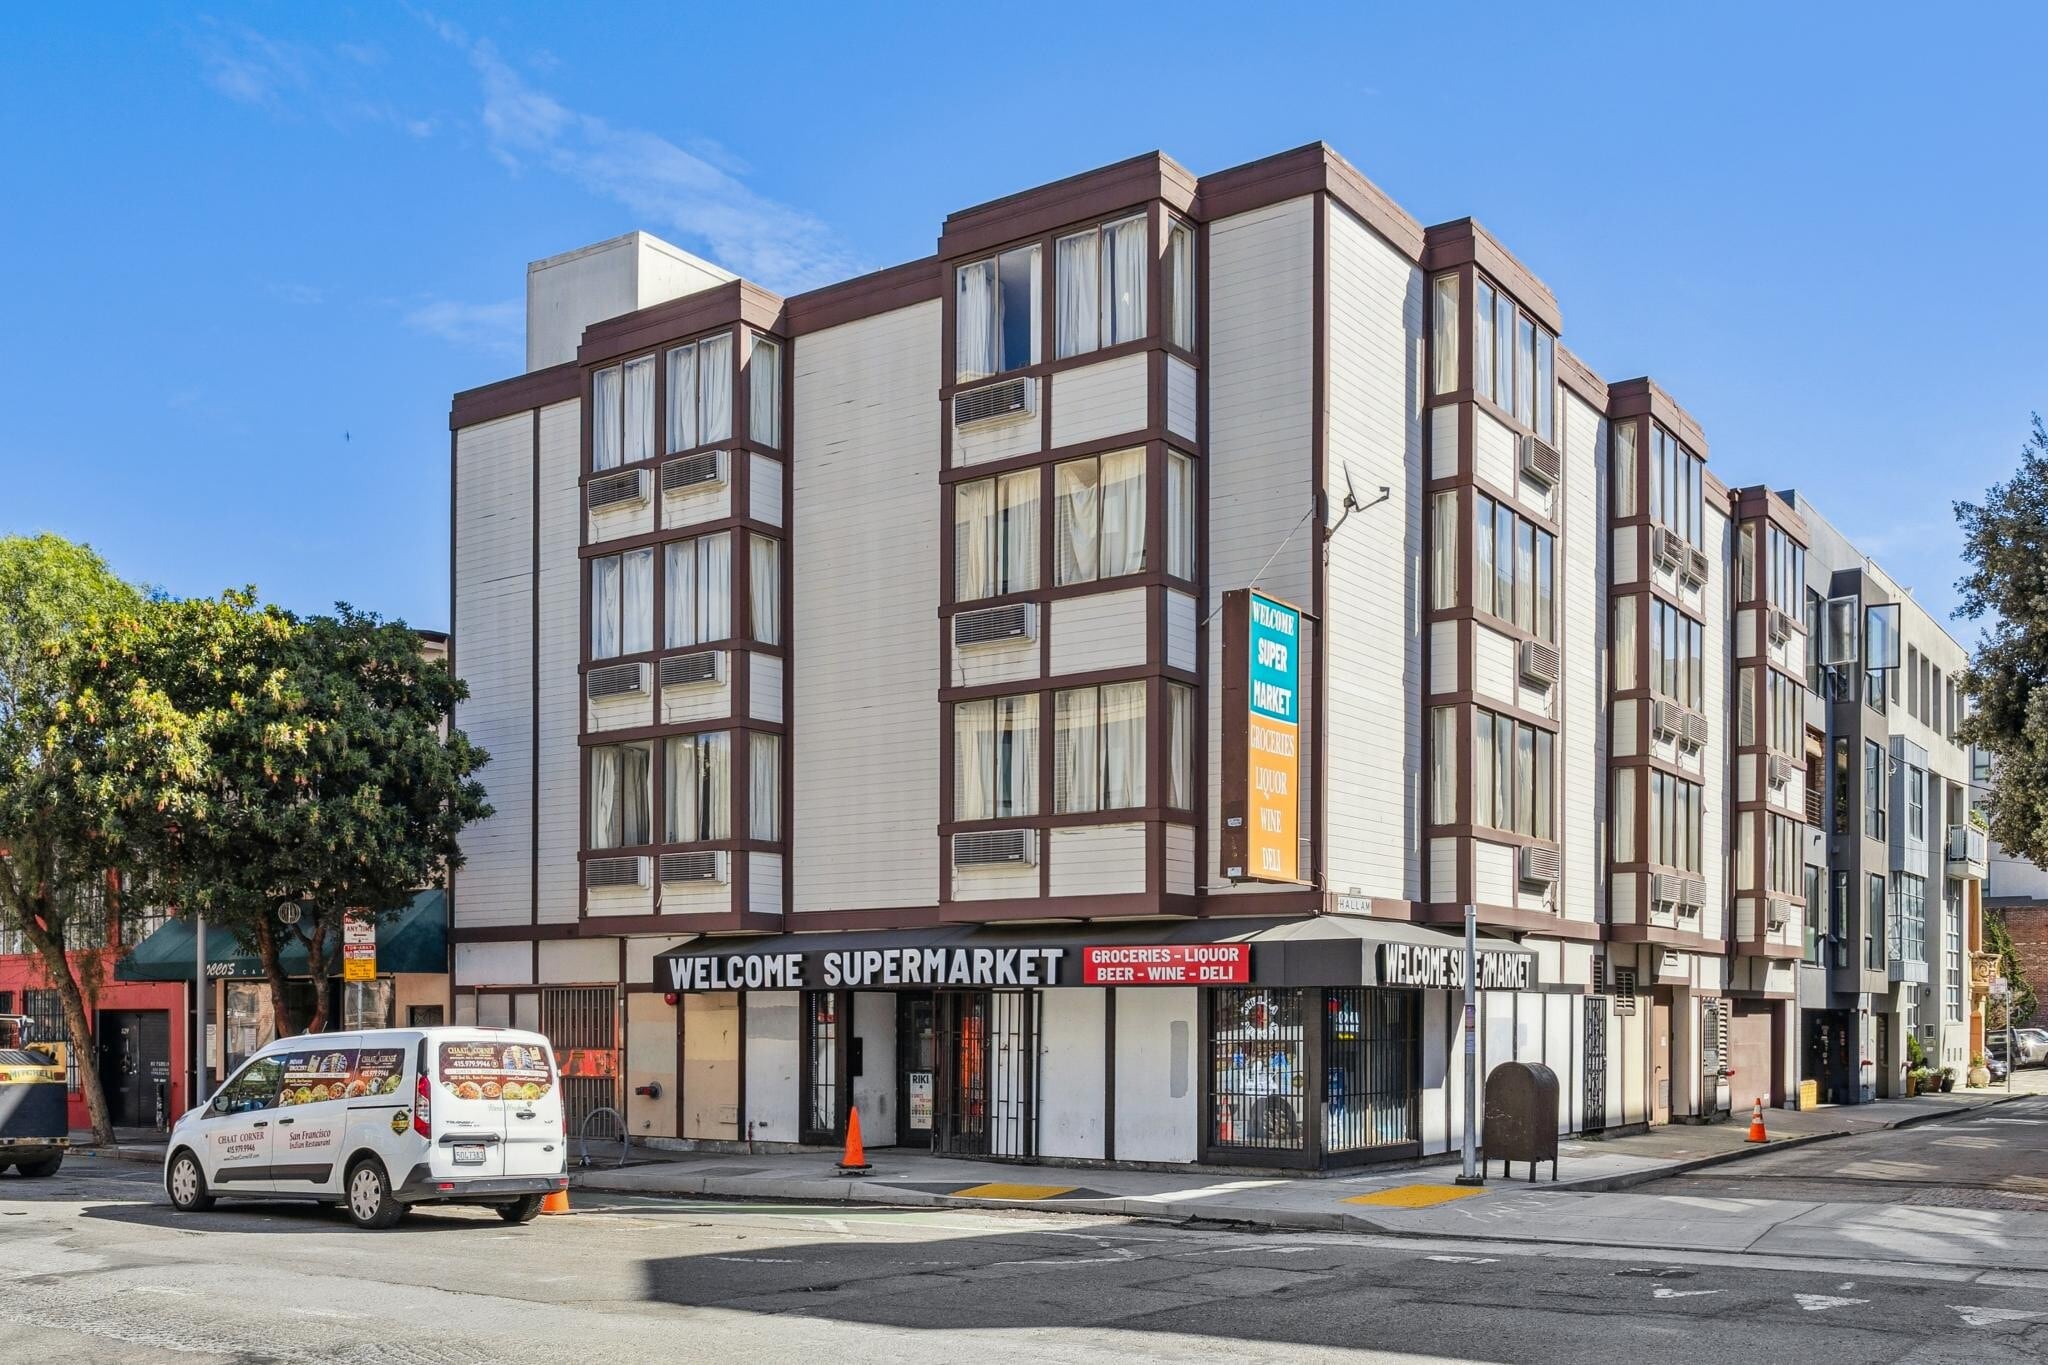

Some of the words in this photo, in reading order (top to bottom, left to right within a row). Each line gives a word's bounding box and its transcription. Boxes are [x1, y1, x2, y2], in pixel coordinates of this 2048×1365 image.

[1253, 601, 1294, 636] WELCOME
[1258, 637, 1287, 672] SUPER
[1253, 680, 1291, 716] MARKET
[1250, 724, 1294, 757] GROCERIES
[1255, 767, 1287, 800] LIQUOR
[1261, 808, 1282, 832] WINE
[1262, 848, 1281, 872] DELI
[1339, 899, 1370, 911] HALLAM
[1092, 949, 1171, 964] GROCERIES
[1184, 947, 1239, 964] LIQUOR
[669, 953, 803, 989] WELCOME
[823, 948, 1064, 986] SUPERMARKET
[1097, 967, 1134, 981] BEER
[1147, 966, 1186, 981] WINE
[1199, 966, 1233, 980] DELI
[1385, 943, 1448, 985] WELCOME
[1450, 949, 1532, 989] SUERMARKET
[453, 1060, 491, 1068] 415.979.9946
[912, 1074, 929, 1084] RIKI
[218, 1134, 237, 1145] CHAAT
[239, 1131, 265, 1142] CORNER
[289, 1131, 301, 1141] San
[302, 1129, 331, 1140] Francisco
[305, 1139, 331, 1148] Restaurant
[226, 1144, 256, 1154] 415.979.9946
